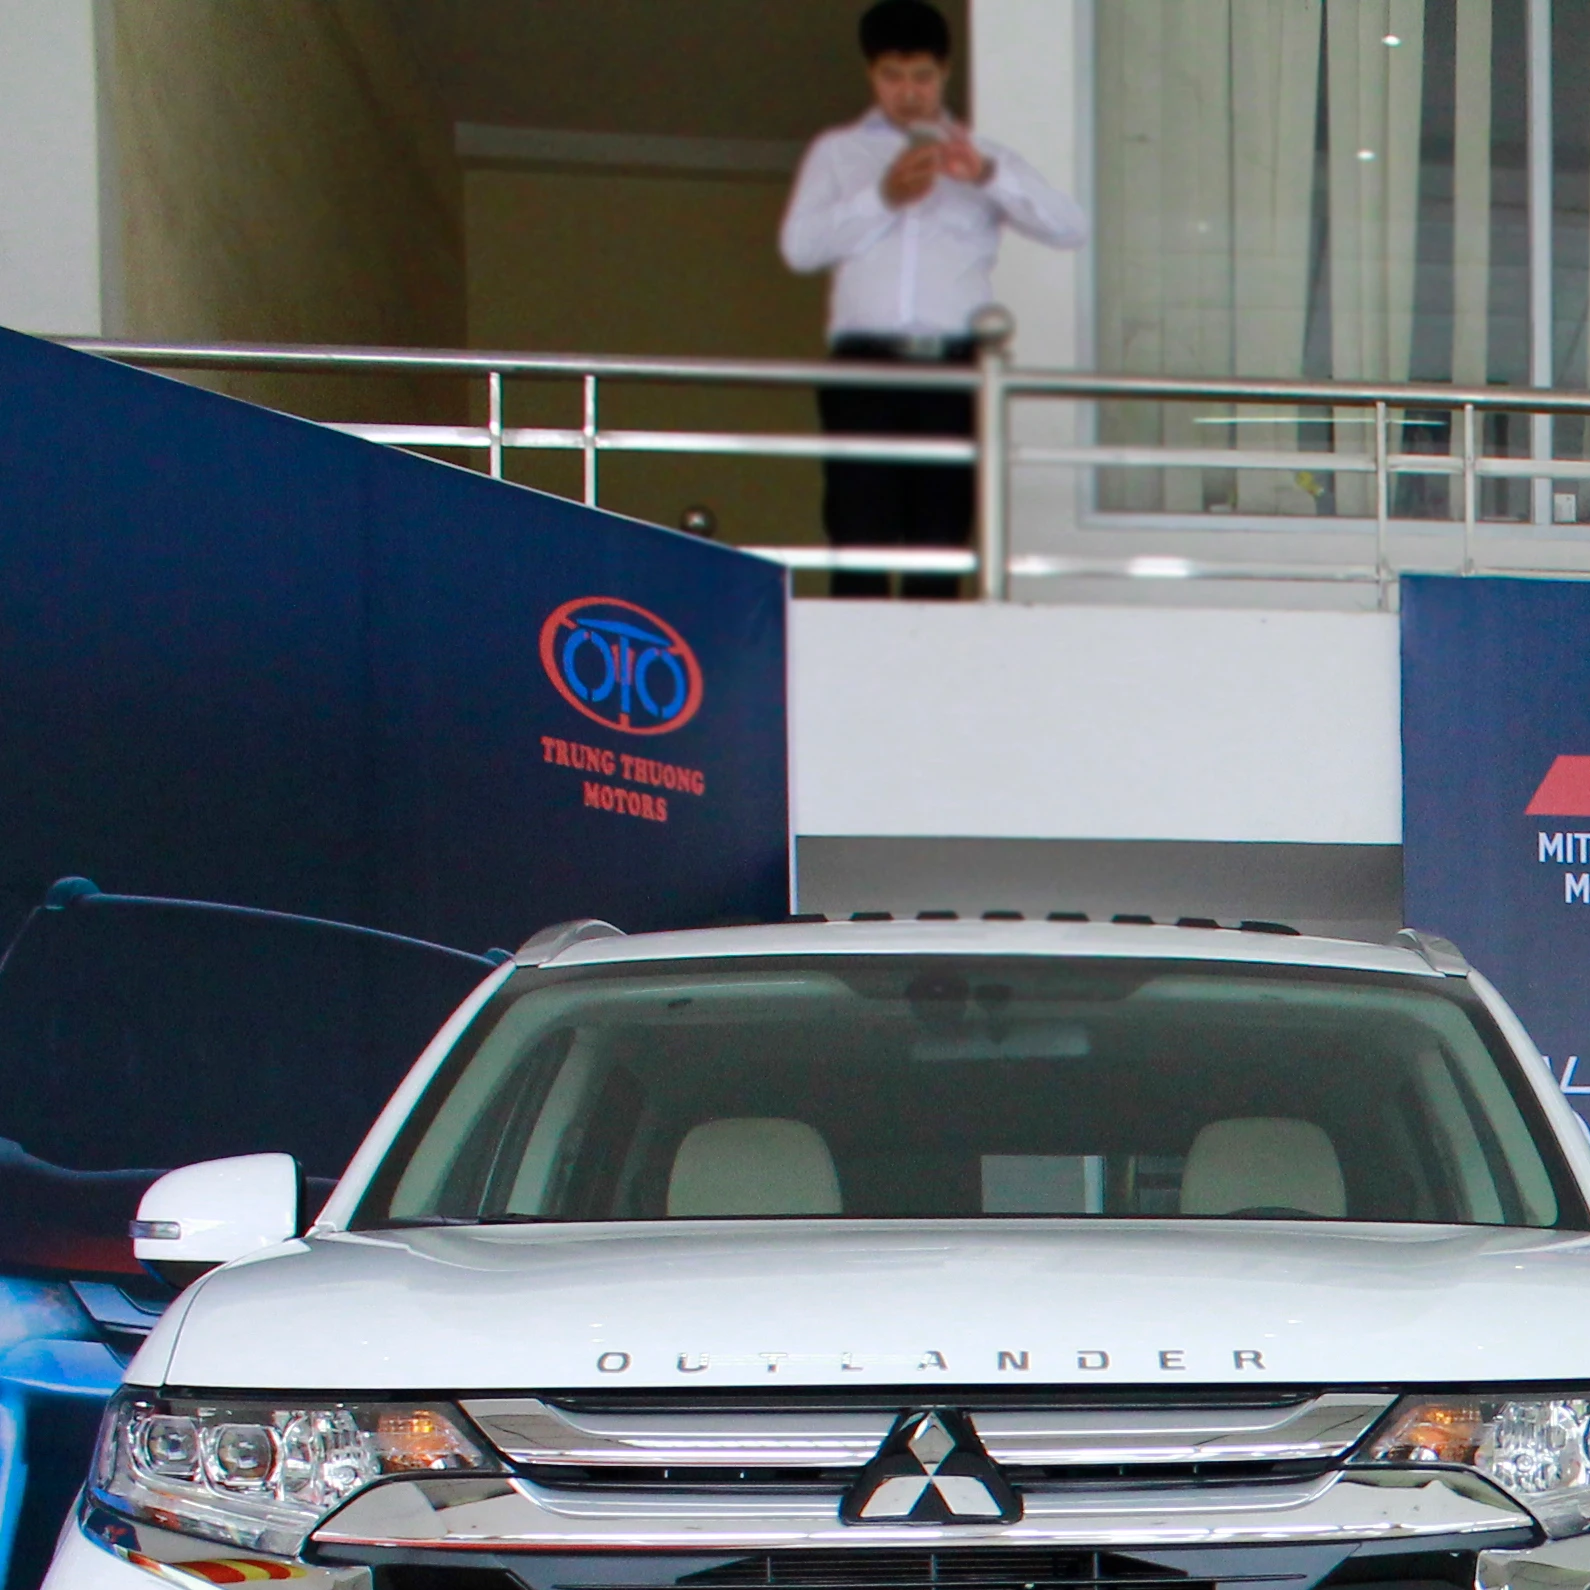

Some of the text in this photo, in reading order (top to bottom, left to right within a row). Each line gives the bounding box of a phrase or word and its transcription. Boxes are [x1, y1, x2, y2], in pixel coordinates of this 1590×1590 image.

[540, 735, 706, 796] TRUNG THUONG
[582, 781, 668, 822] MOTORS
[597, 1350, 1267, 1373] OUTLANDER
